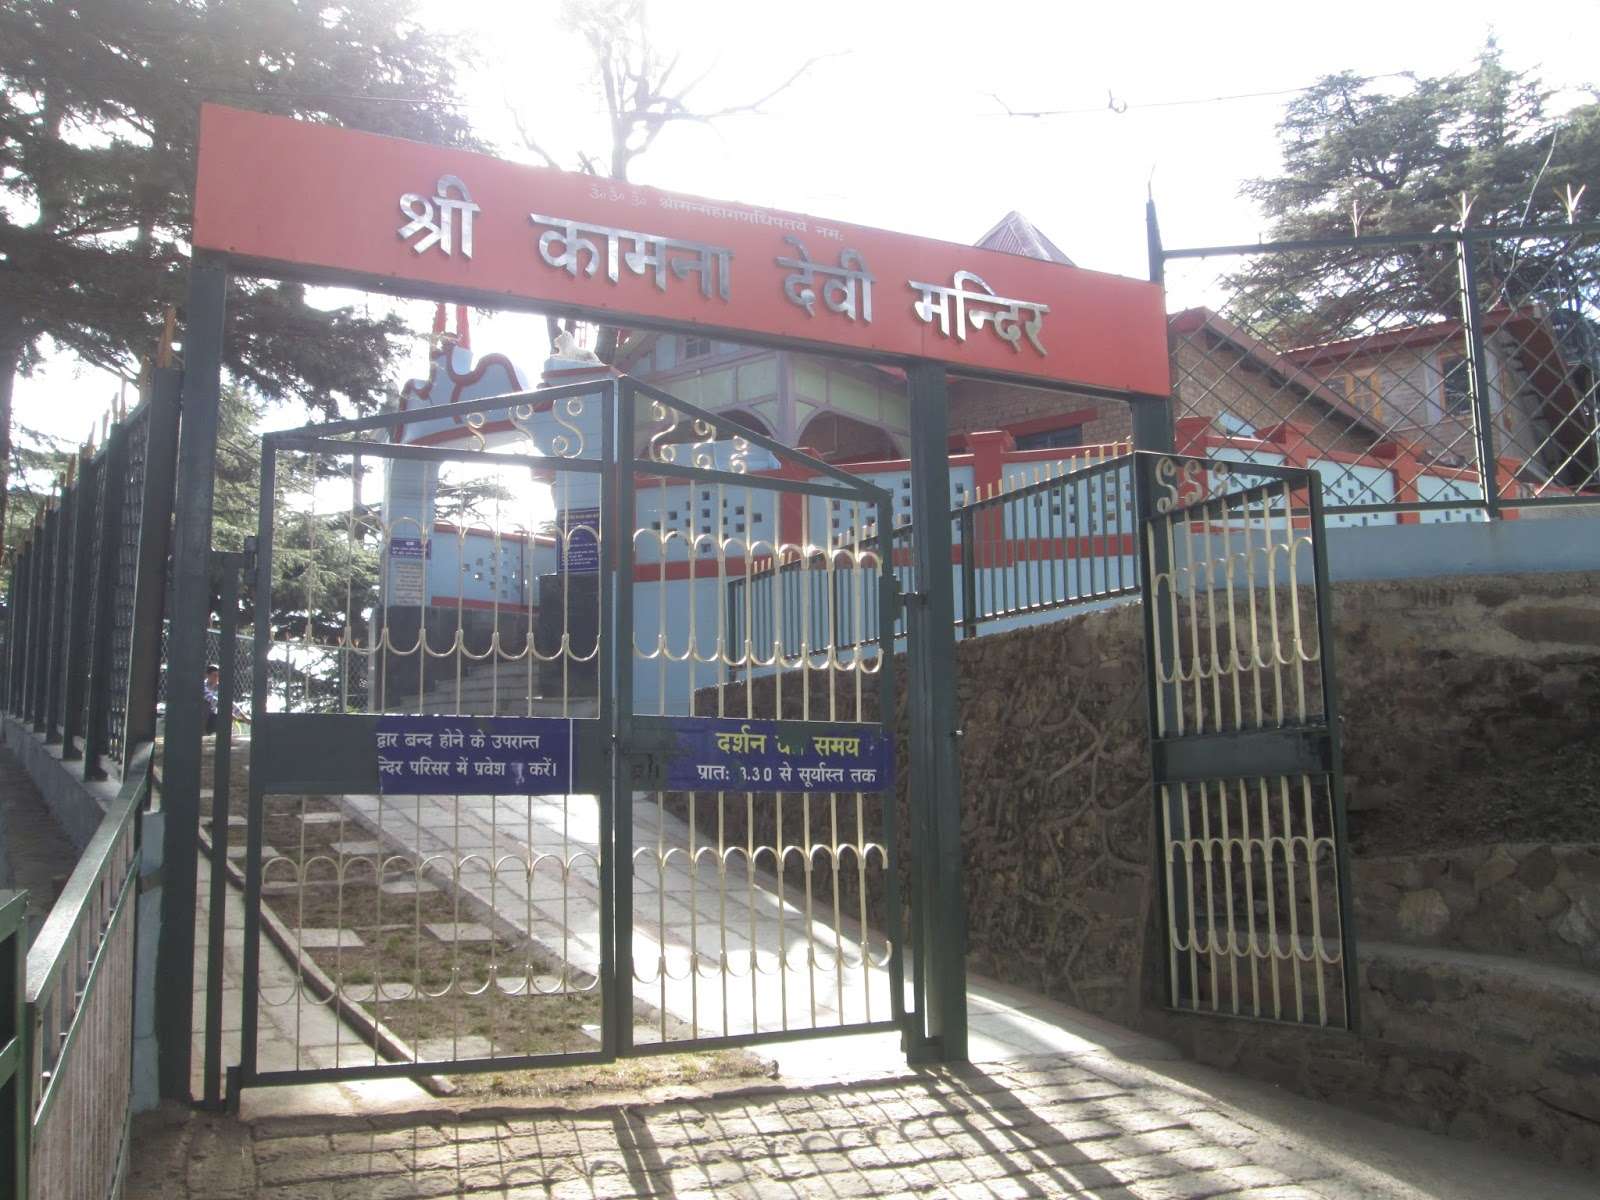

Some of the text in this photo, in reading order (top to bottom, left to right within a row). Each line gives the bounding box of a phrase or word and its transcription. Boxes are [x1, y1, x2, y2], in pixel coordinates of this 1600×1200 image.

[397, 174, 1051, 357] श्री कामना देवी मन्दिर
[376, 728, 541, 751] द्वार बन्द होने के उपरान्त
[714, 723, 767, 755] दर्शन
[812, 736, 861, 758] समय
[409, 755, 452, 777] परिसर
[456, 756, 469, 776] में
[473, 756, 507, 777] प्रवेश
[778, 761, 793, 782] से
[797, 761, 845, 788] सूर्यास्त
[848, 768, 878, 783] तक
